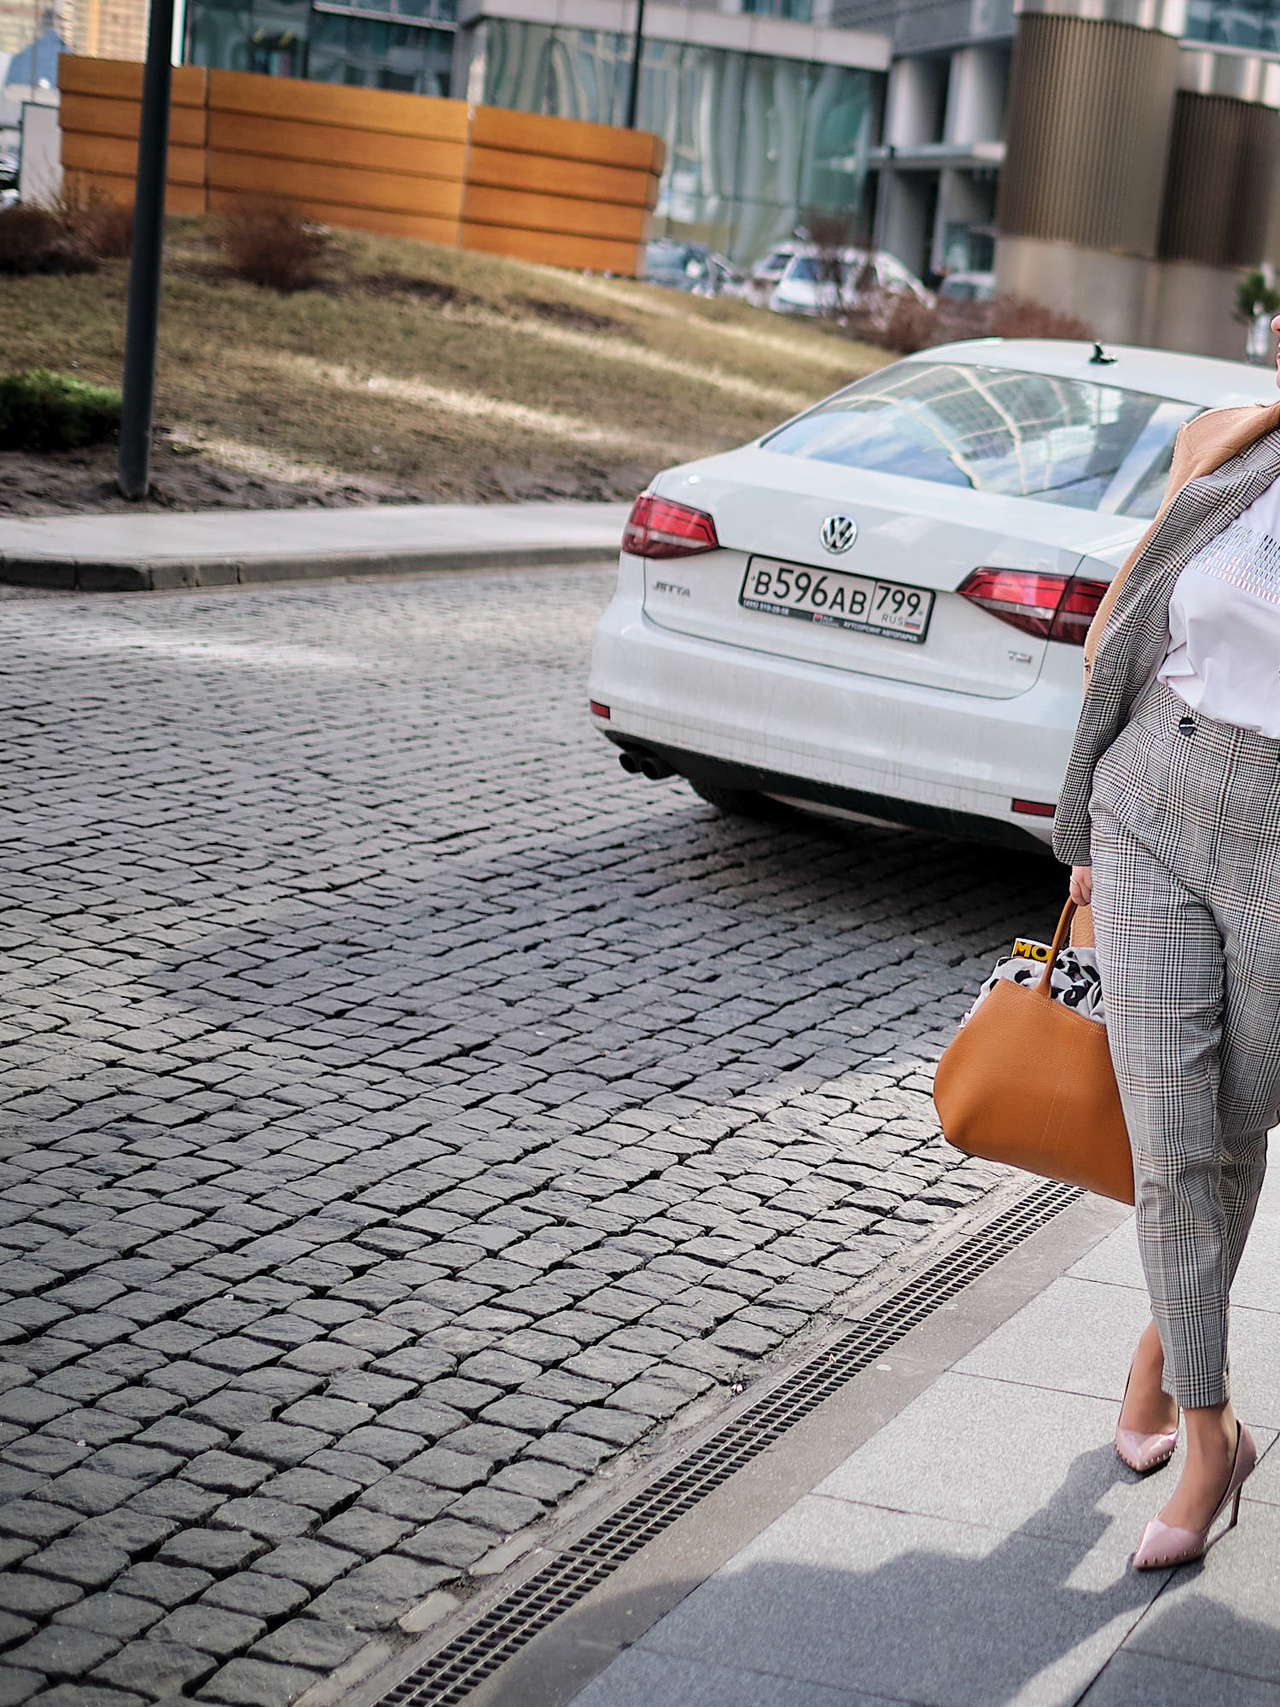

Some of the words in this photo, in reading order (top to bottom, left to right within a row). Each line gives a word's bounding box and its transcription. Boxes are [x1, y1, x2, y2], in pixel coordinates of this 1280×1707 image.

[652, 581, 690, 598] JETTA
[876, 586, 921, 617] 799
[881, 614, 904, 626] RUS
[843, 621, 881, 634] АУТСОРСИНГ
[881, 629, 918, 642] АВТОПАРКА
